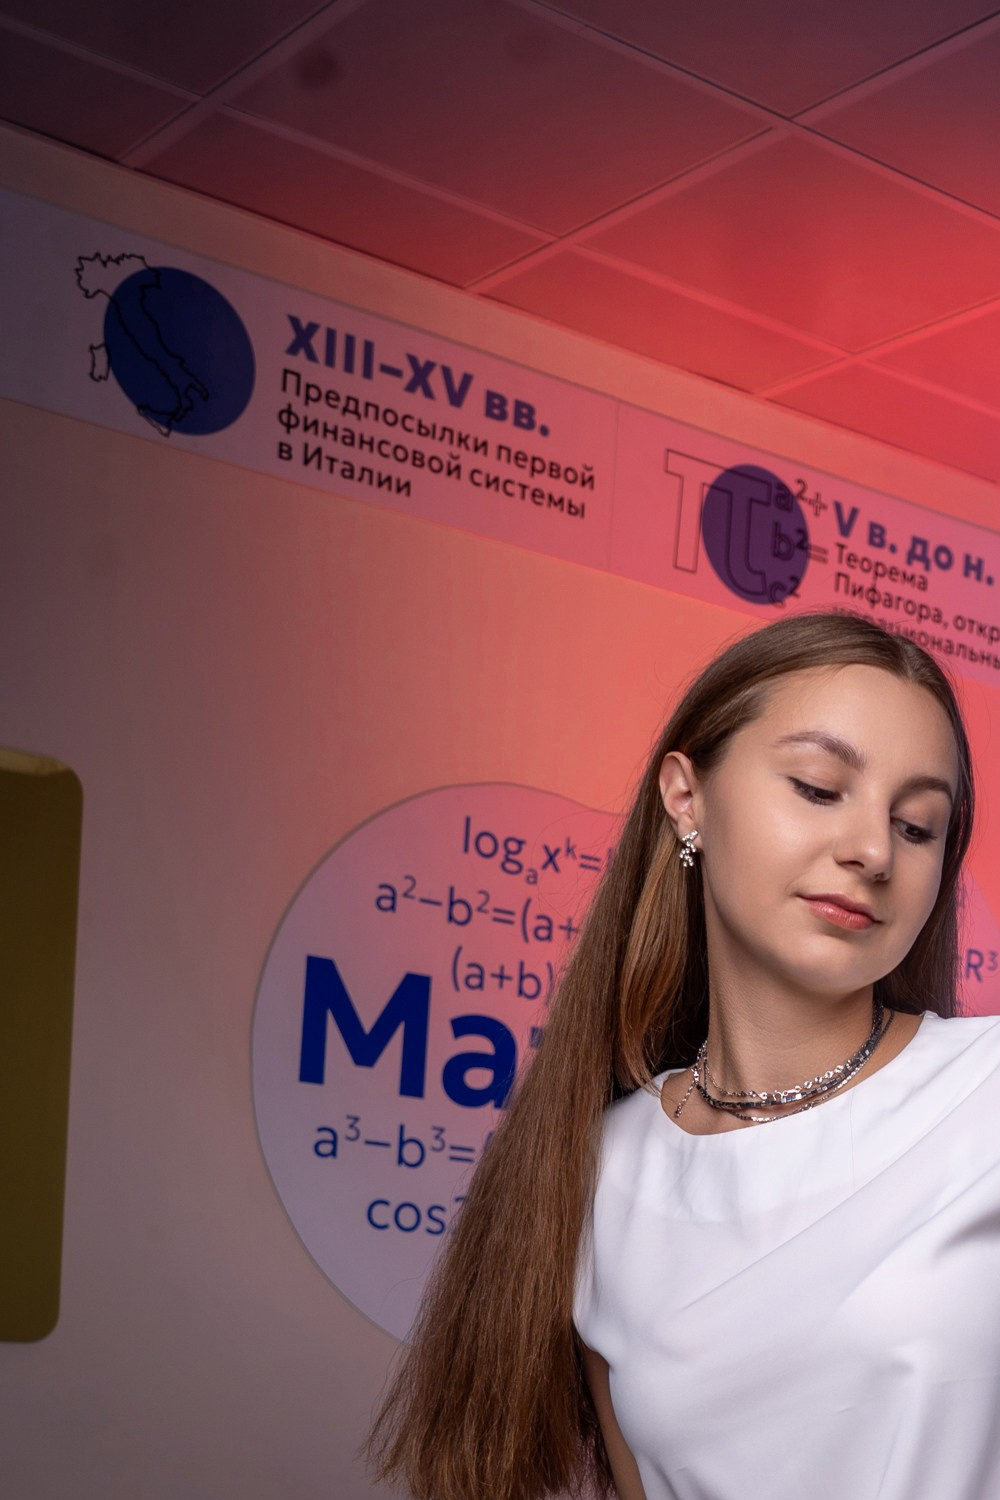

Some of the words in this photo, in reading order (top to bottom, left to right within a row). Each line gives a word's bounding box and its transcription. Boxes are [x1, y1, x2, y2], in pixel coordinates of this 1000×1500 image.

[281, 368, 489, 456] Предпосылки
[497, 444, 595, 490] первой
[484, 389, 550, 437] вв.
[278, 403, 462, 480] финансовой
[469, 469, 585, 519] системы
[278, 441, 293, 461] в
[302, 442, 411, 497] Италии
[833, 501, 860, 538] V
[868, 521, 897, 553] в.
[906, 535, 954, 571] до
[963, 553, 994, 586] н.
[835, 543, 928, 591] Теорема
[834, 572, 948, 629] Пифагора,
